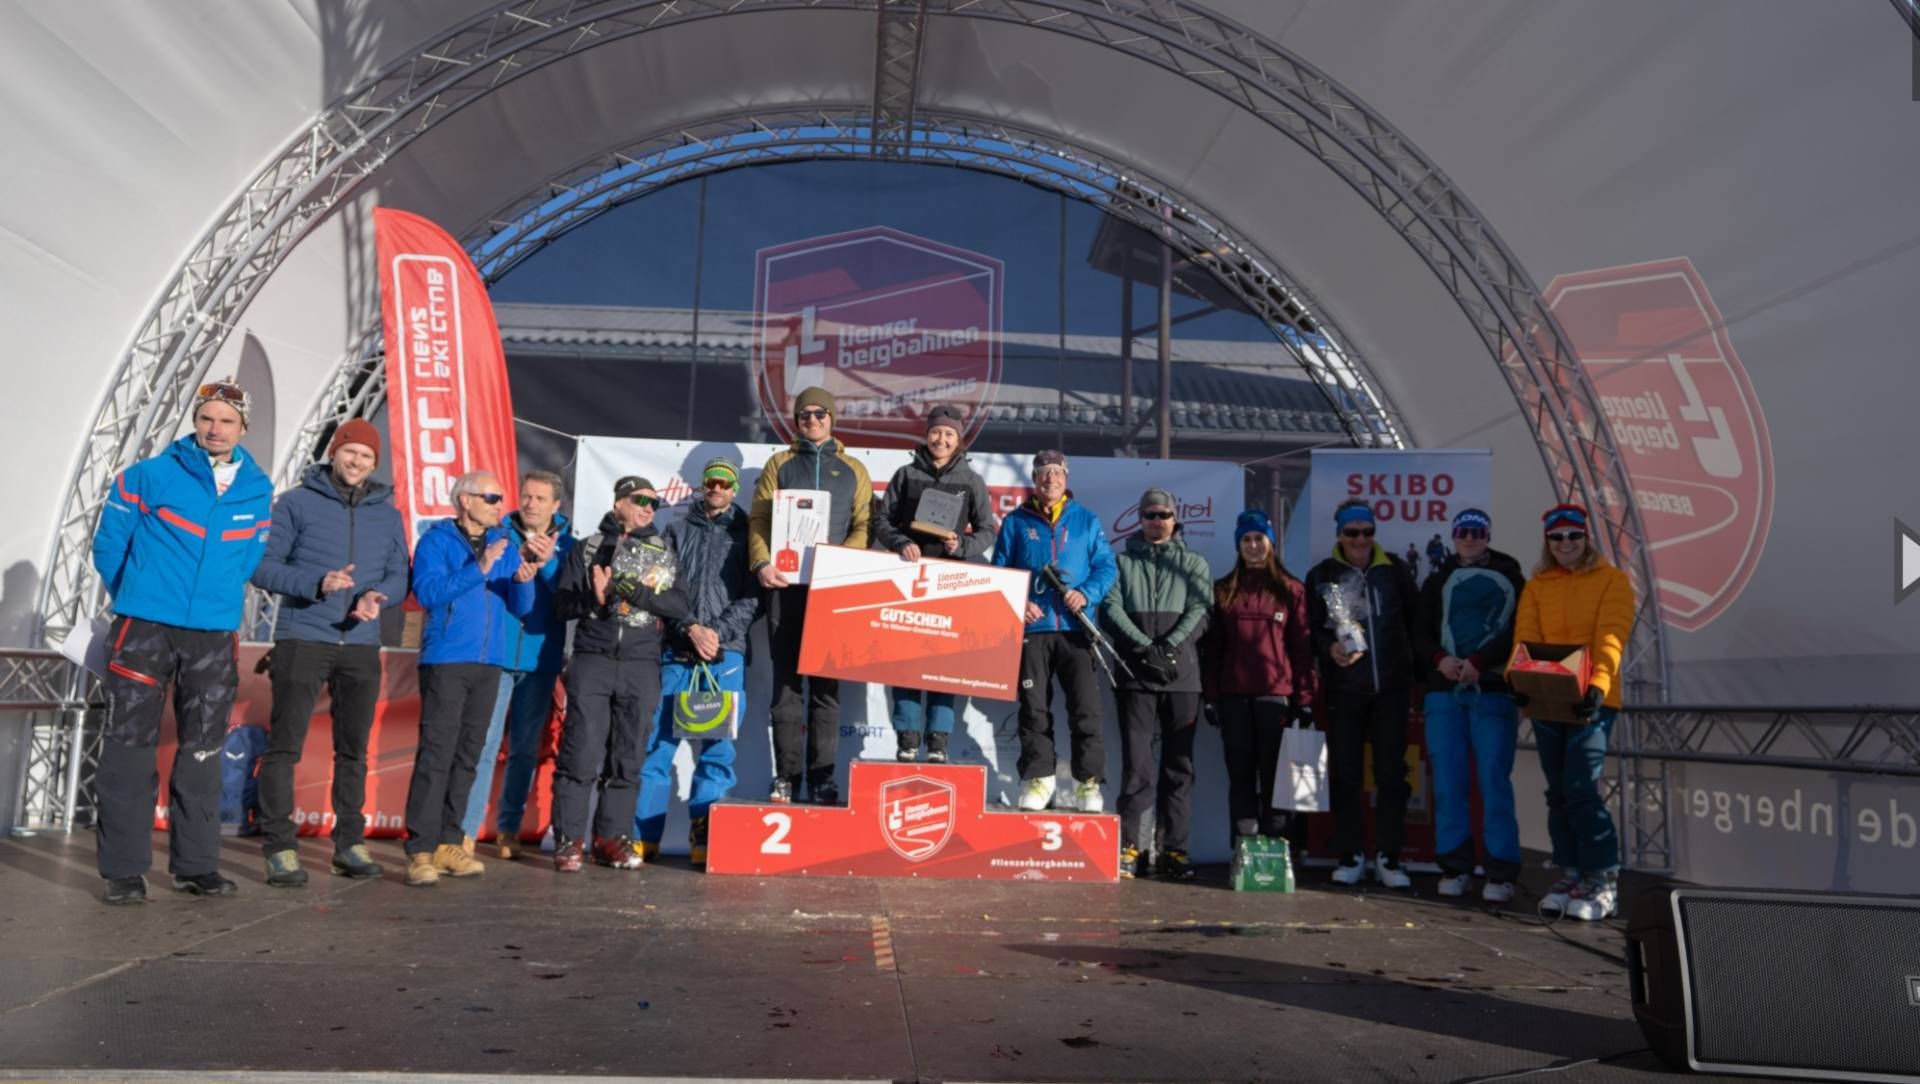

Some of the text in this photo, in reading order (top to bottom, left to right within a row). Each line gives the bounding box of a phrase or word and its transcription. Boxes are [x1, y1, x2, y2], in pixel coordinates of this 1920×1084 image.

[838, 325, 979, 369] bergbahnen
[1346, 473, 1455, 496] SKIBO
[1364, 499, 1448, 522] OUR
[937, 577, 991, 591] bergbahnen
[880, 607, 953, 630] GUTSCHEIN
[760, 812, 792, 855] 2
[1041, 821, 1063, 851] 3
